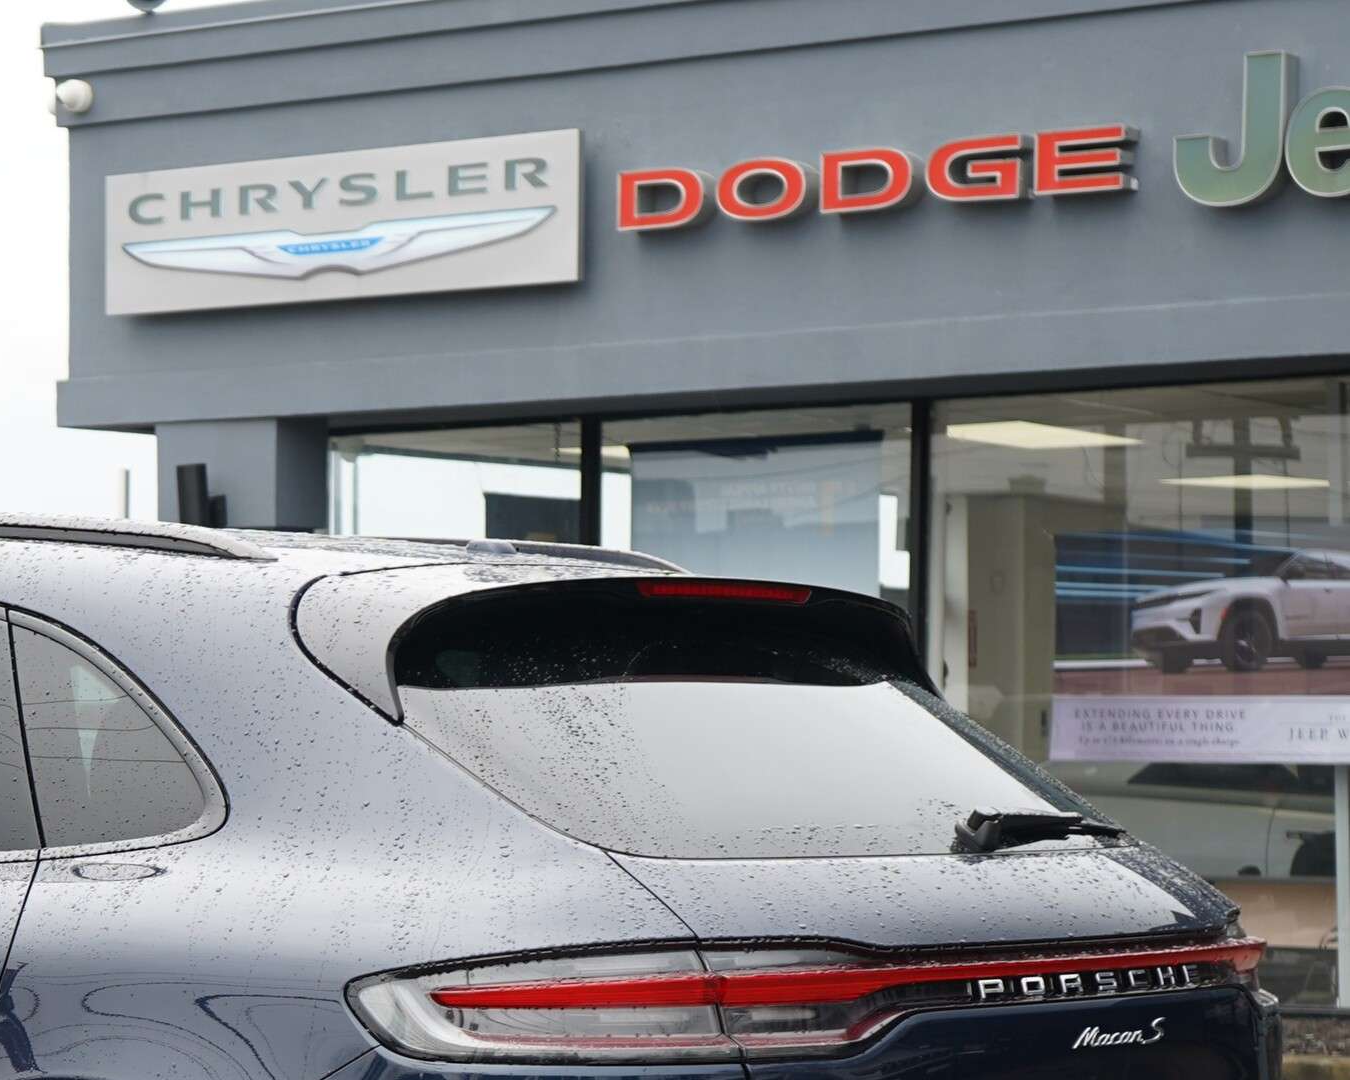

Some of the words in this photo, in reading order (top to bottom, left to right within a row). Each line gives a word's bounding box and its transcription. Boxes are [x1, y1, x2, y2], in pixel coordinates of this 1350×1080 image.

[1172, 49, 1350, 207] Je
[126, 155, 551, 227] CHRYSLER
[616, 122, 1138, 232] DODGE
[1074, 708, 1151, 720] EXTENDING
[1157, 708, 1198, 720] EVERY
[1205, 708, 1246, 720] DRIVE
[1112, 721, 1185, 733] BEAUTIFUL
[1191, 720, 1234, 733] THING
[978, 964, 1198, 999] PORSCHE
[1072, 1026, 1145, 1050] Macan
[1143, 1016, 1167, 1044] S
